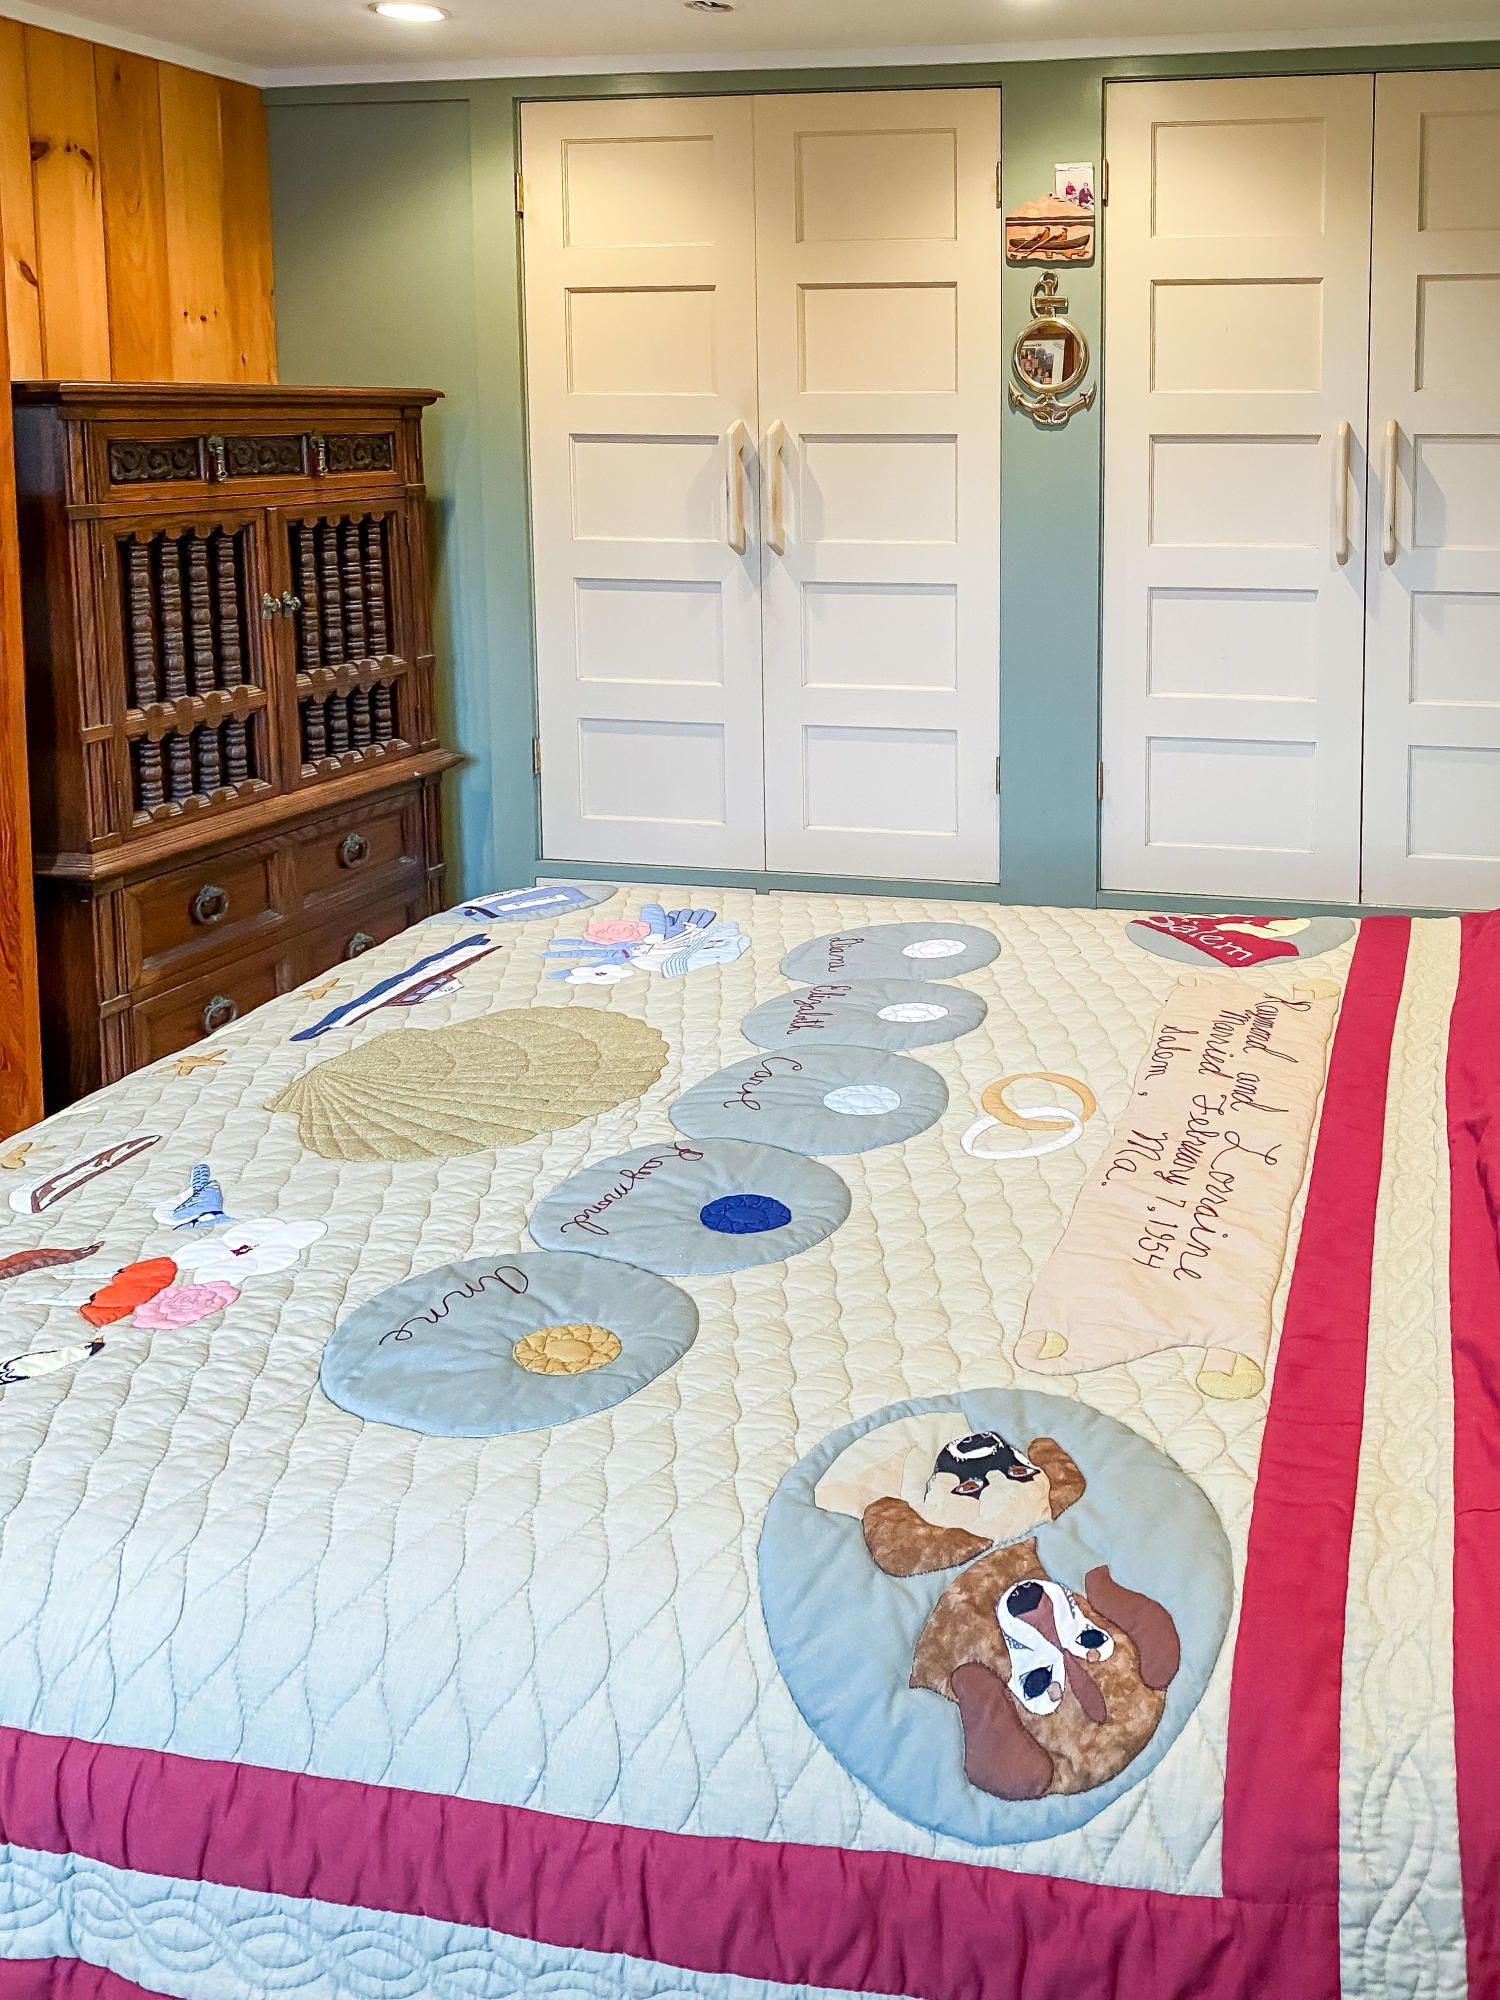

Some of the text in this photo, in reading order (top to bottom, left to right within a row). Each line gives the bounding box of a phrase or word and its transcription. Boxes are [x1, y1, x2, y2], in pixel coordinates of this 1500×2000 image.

[1145, 915, 1253, 962] Salem
[786, 985, 852, 1035] Elizabeth
[1197, 1009, 1253, 1080] Married
[723, 1056, 803, 1111] Carol
[1153, 1093, 1228, 1186] February
[1172, 992, 1313, 1281] Raymond and Lorraine
[560, 1141, 705, 1236] Raymond
[1131, 1218, 1179, 1269] 1954
[378, 1265, 530, 1346] Anne
